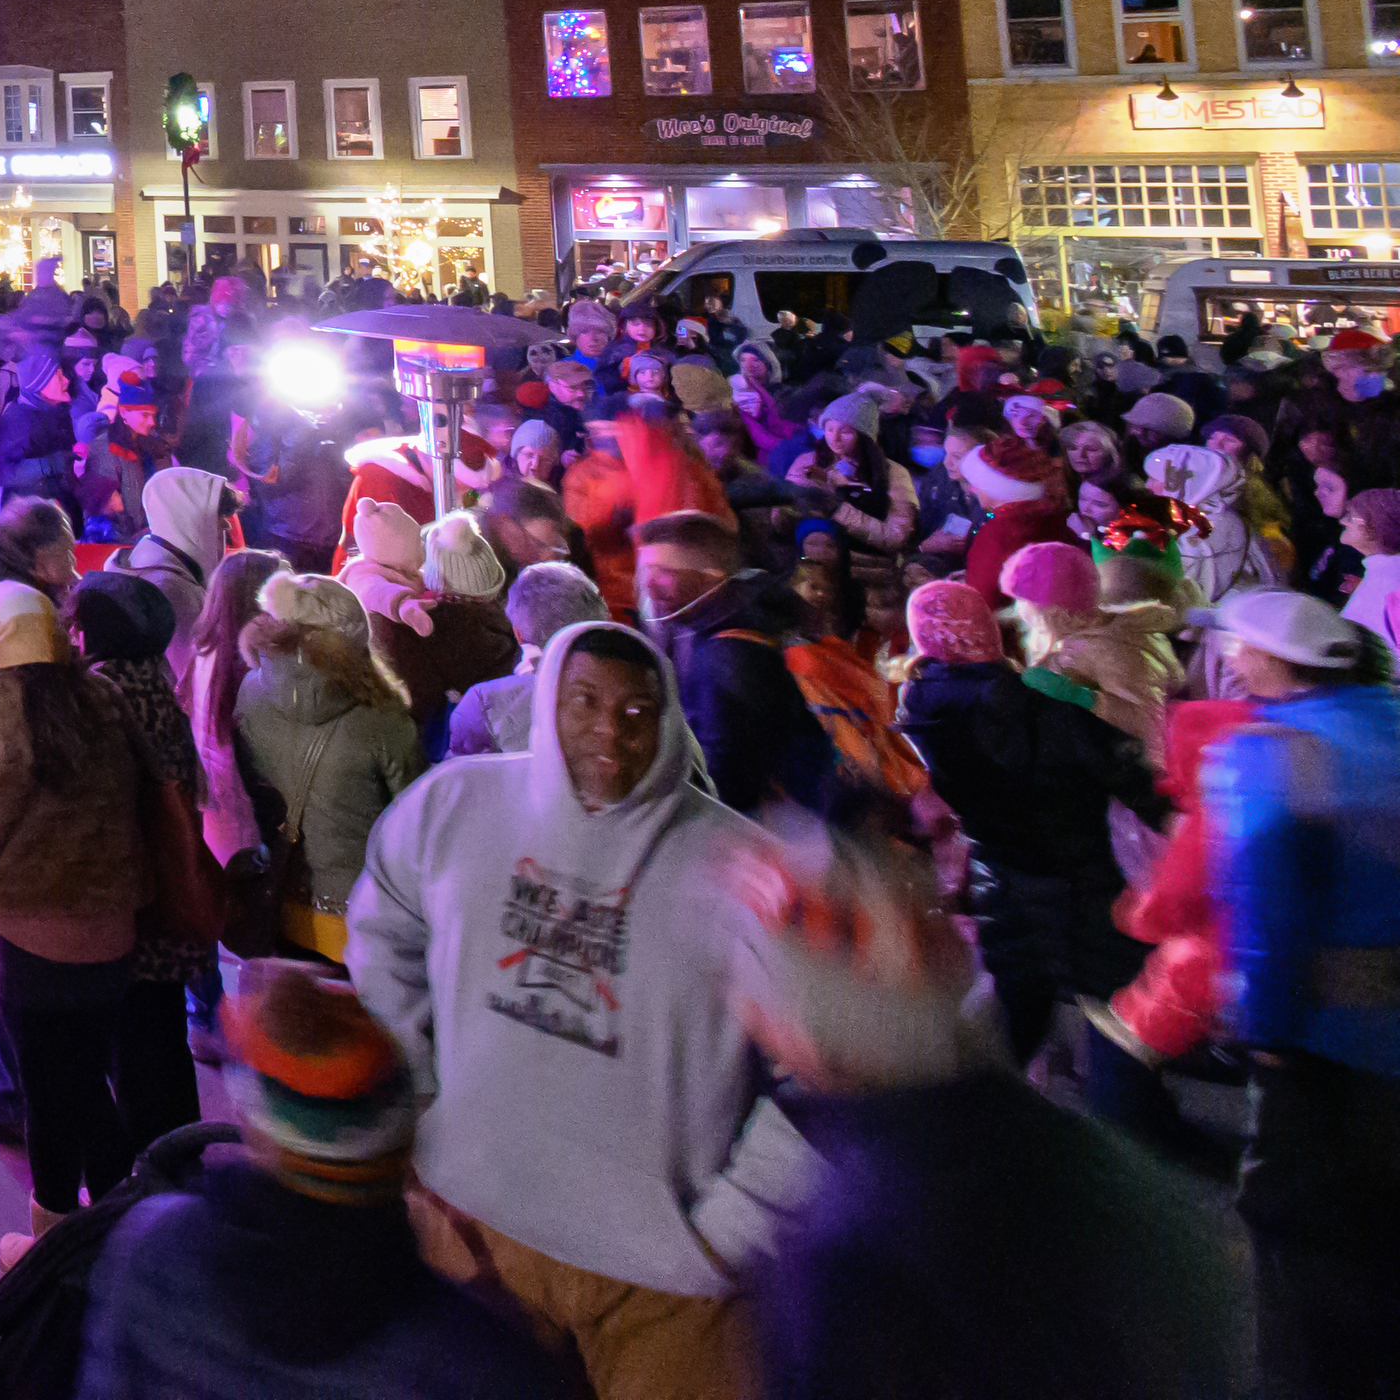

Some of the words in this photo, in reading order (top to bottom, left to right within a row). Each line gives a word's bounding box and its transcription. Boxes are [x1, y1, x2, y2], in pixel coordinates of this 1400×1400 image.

[1131, 97, 1322, 123] HOMESTEAD
[657, 114, 716, 139] Moe's
[723, 112, 814, 139] Original
[354, 221, 370, 232] 116
[1328, 269, 1361, 280] BLACK
[1363, 268, 1391, 279] BEAR
